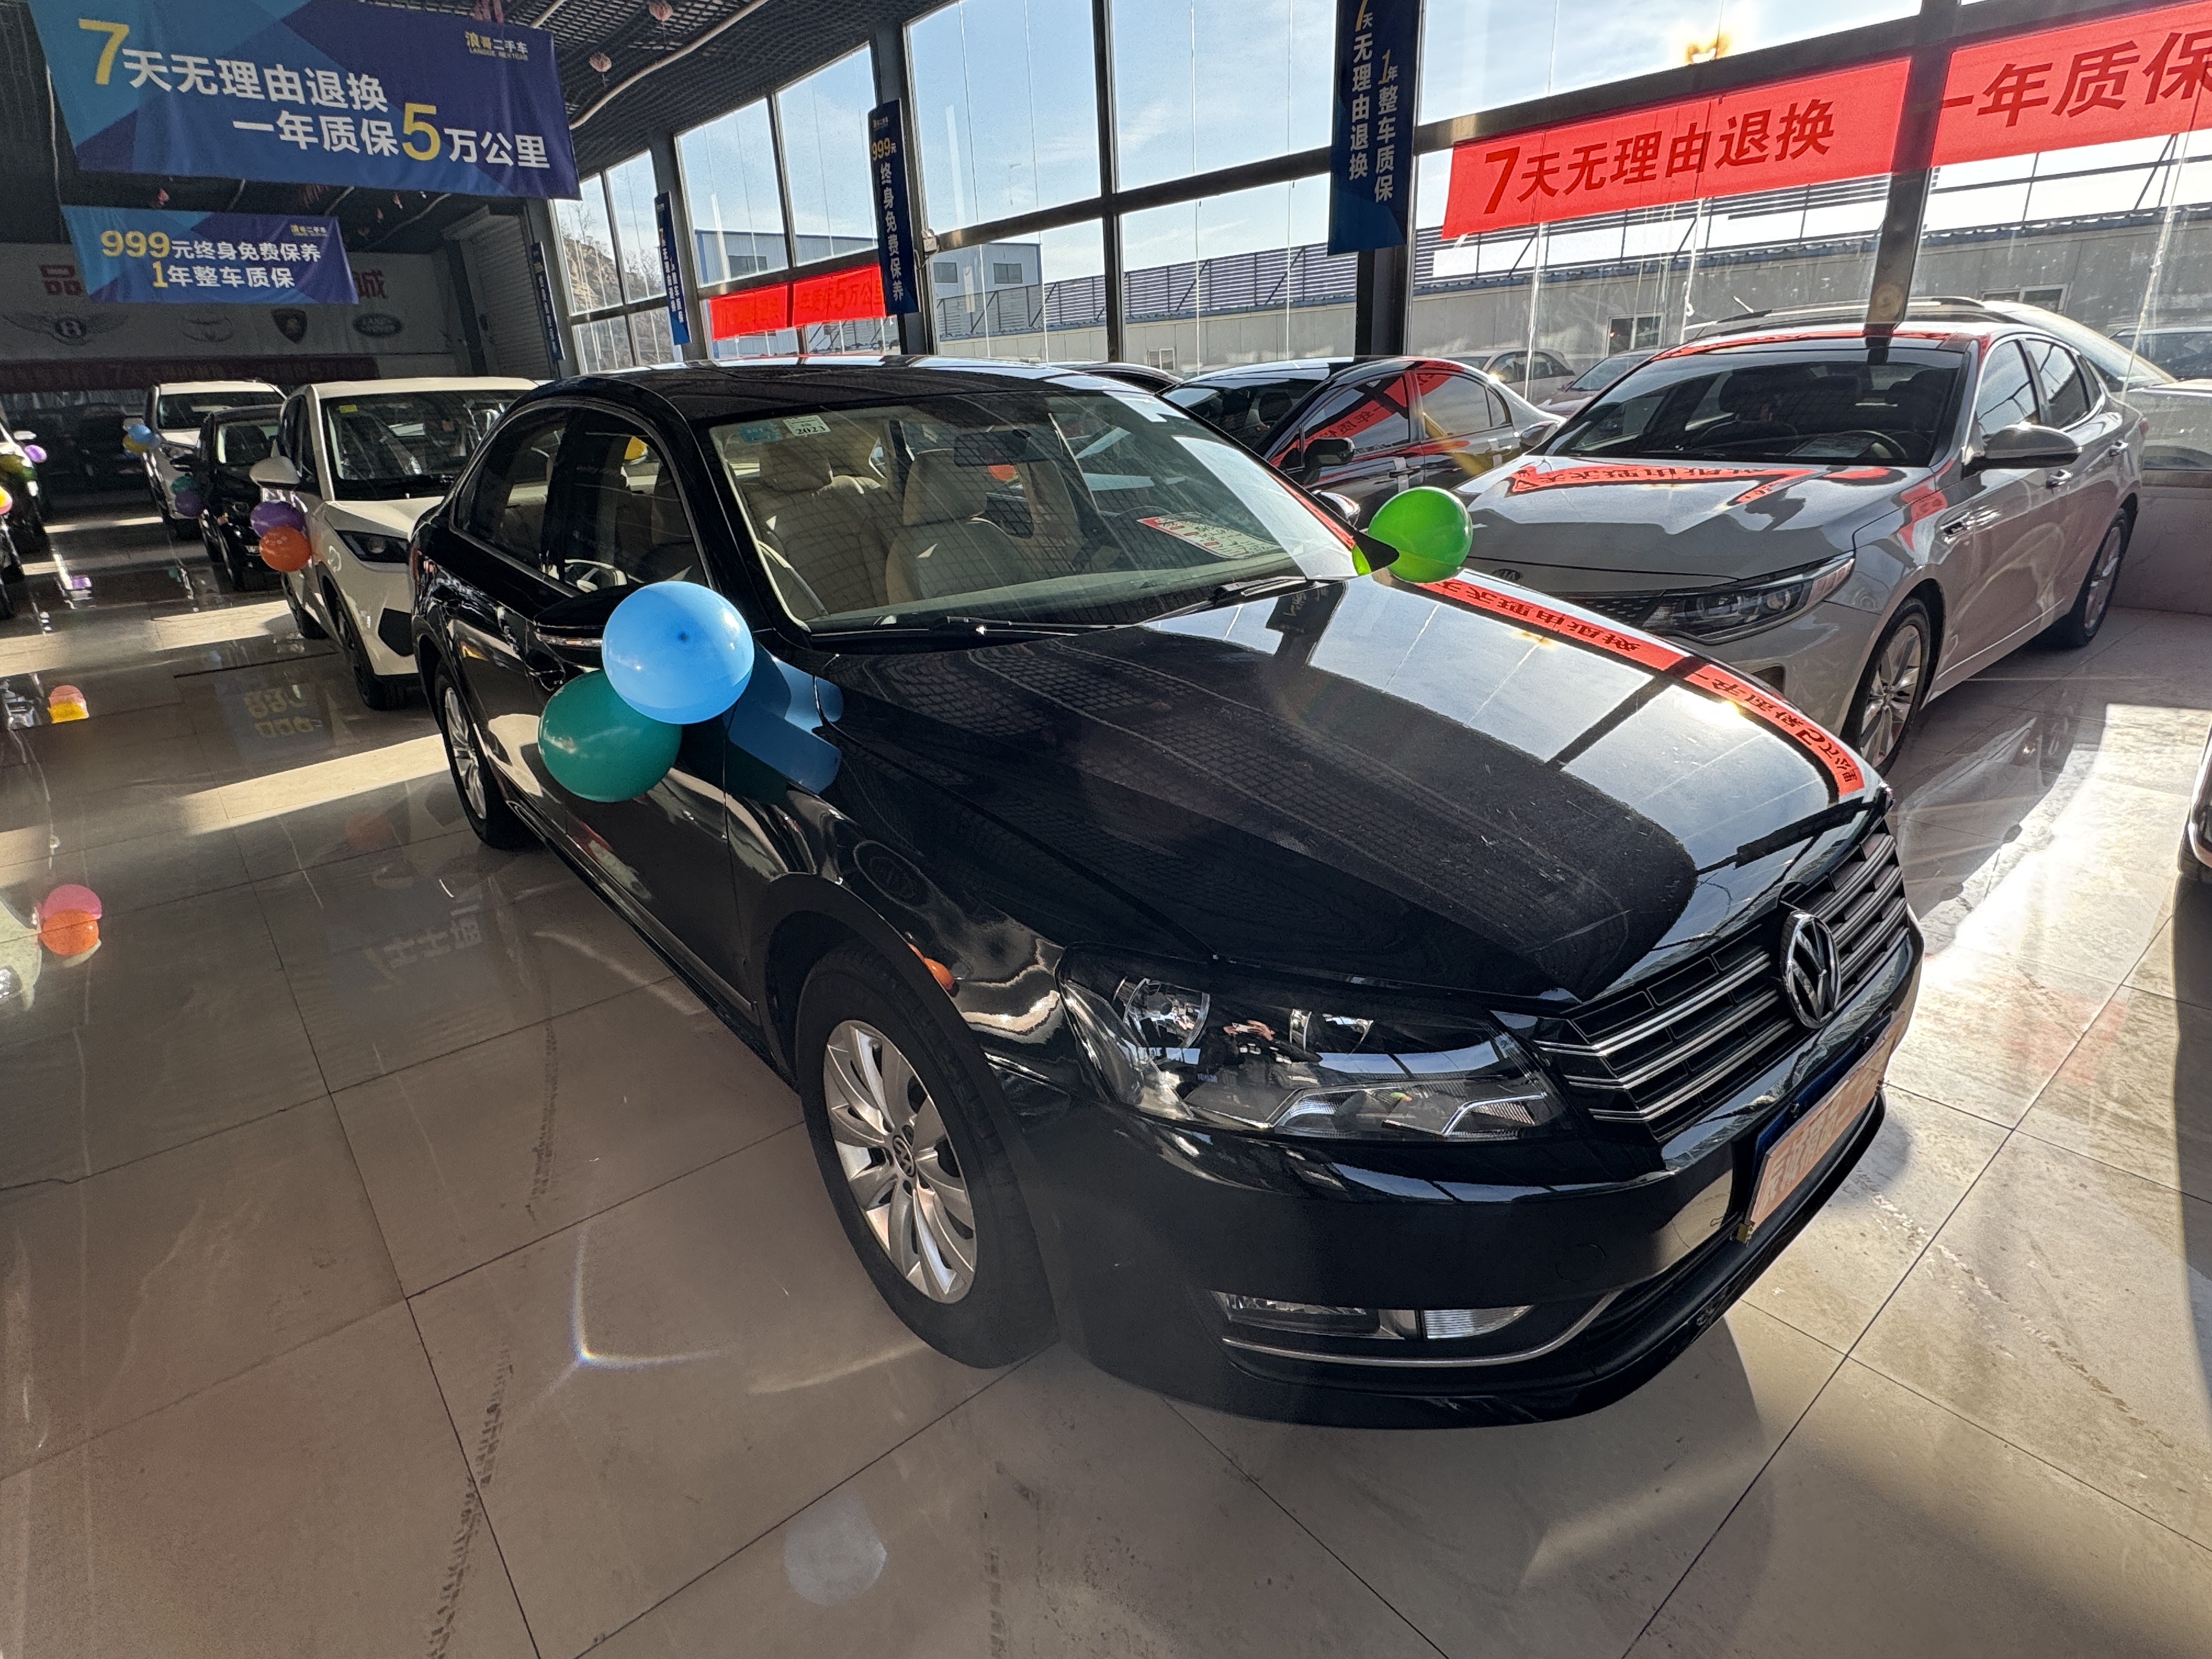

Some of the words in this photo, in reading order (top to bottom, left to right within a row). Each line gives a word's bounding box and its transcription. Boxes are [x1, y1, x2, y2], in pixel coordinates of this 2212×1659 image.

[78, 19, 388, 112] 7天无理由退换
[233, 103, 550, 170] 一年质保5万公里
[1483, 98, 1835, 215] 7天无理由退换
[101, 230, 322, 263] 999元终身免费保养
[152, 262, 295, 289] 1年整车质保
